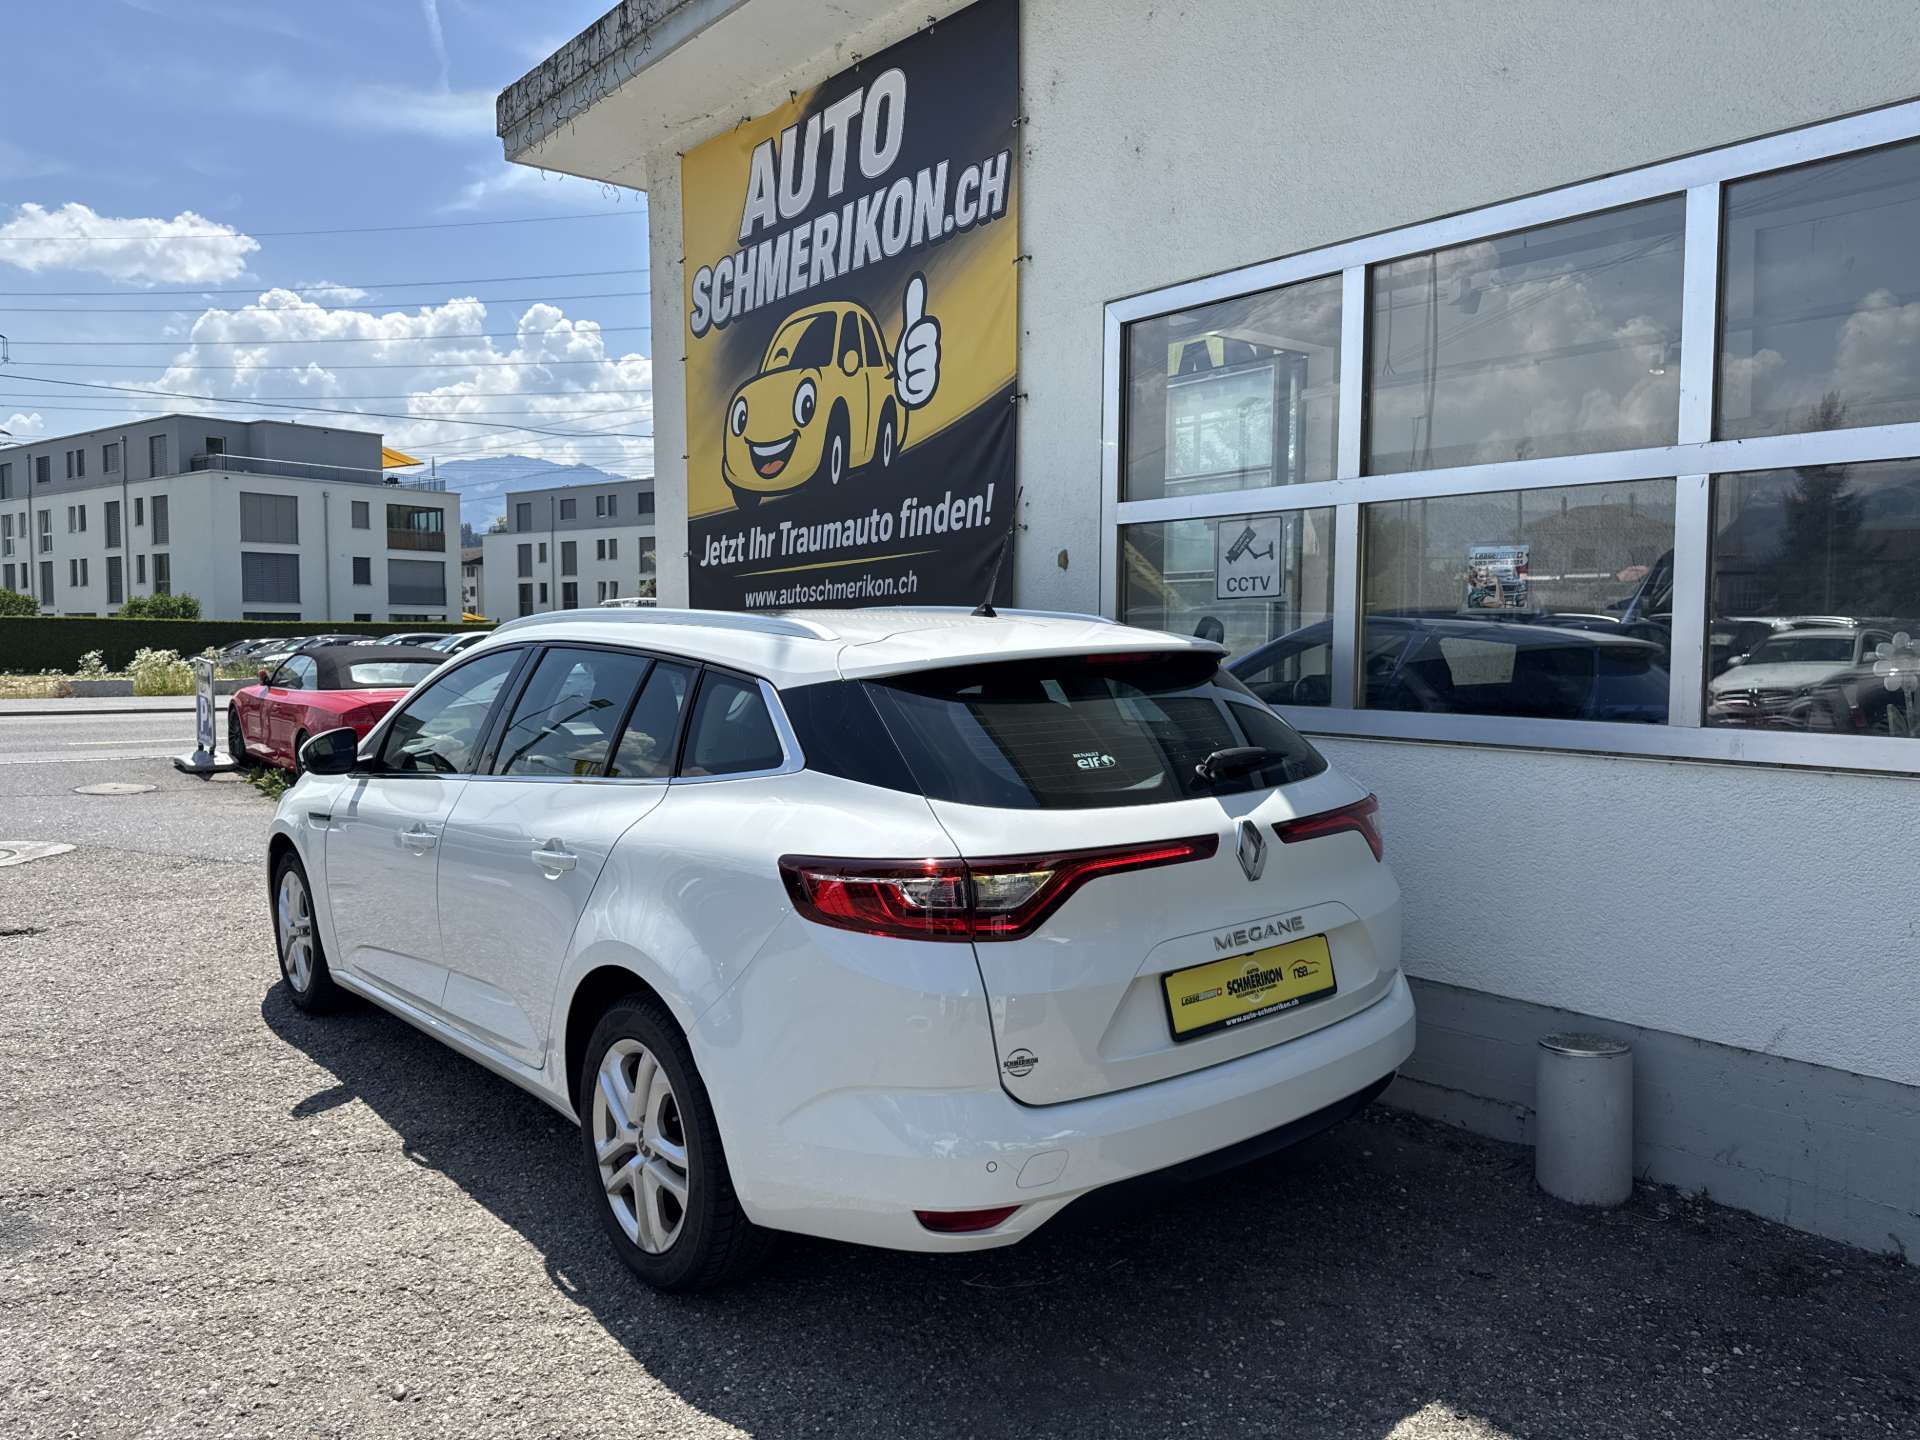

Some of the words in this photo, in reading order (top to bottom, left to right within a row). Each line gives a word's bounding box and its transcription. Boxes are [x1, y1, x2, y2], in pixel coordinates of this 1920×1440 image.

[739, 68, 907, 241] AUTO
[690, 150, 1011, 336] SCHMERIKON.CH
[700, 529, 745, 567] Jetzt
[748, 526, 776, 561] Ihr
[779, 507, 894, 557] Traumauto
[900, 482, 995, 539] finden!
[745, 570, 917, 608] www.autoschmerikon.ch
[1226, 576, 1270, 592] CCTV
[1077, 757, 1100, 769] elf
[1213, 916, 1305, 951] MEGANE
[1226, 967, 1284, 996] SCHMERIKON
[1226, 999, 1299, 1026] www.auto-schmerikon.ch
